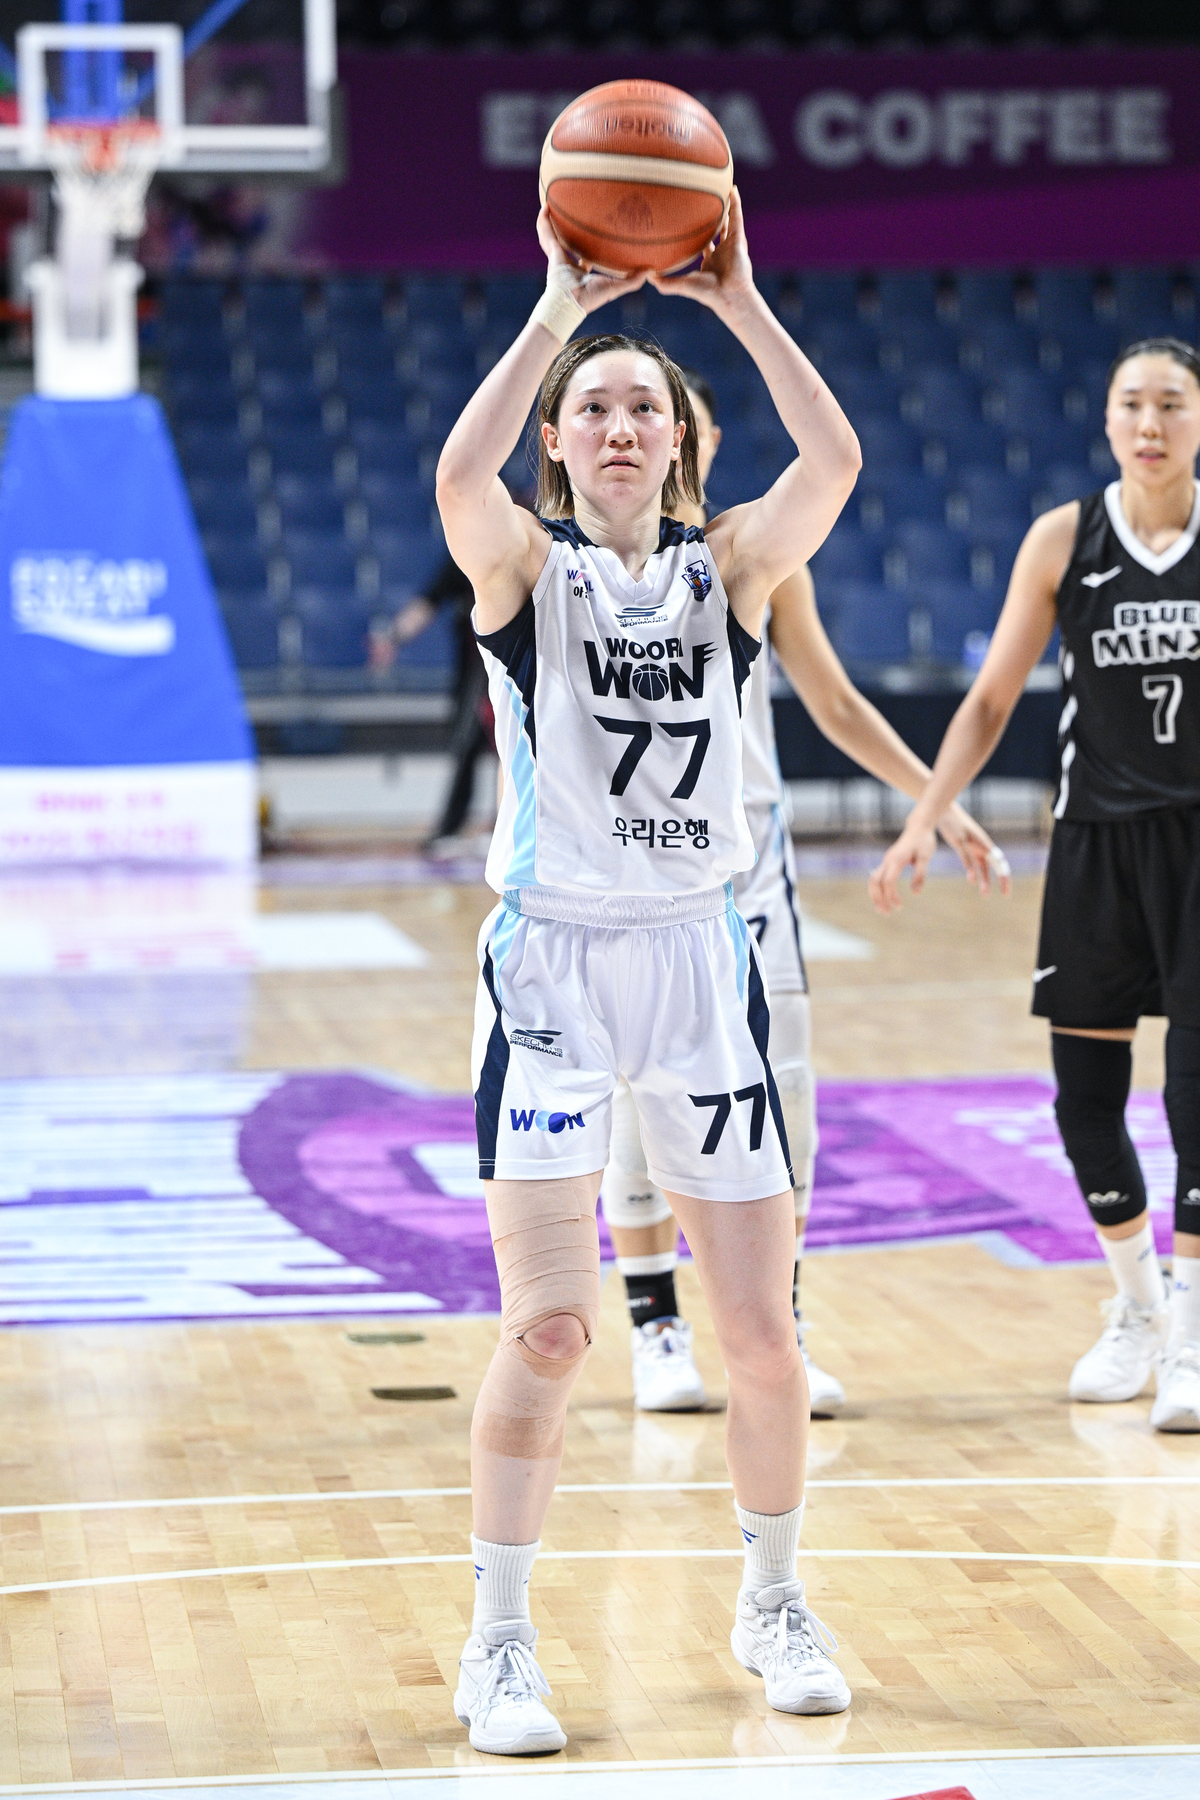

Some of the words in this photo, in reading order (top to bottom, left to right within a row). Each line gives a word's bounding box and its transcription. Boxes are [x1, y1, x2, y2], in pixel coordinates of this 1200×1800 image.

[796, 89, 1169, 166] COFFEE
[1116, 603, 1200, 629] BLUE
[1142, 674, 1183, 744] 7
[592, 714, 711, 800] 77
[612, 816, 710, 849] 우리은행
[687, 1082, 766, 1155] 77
